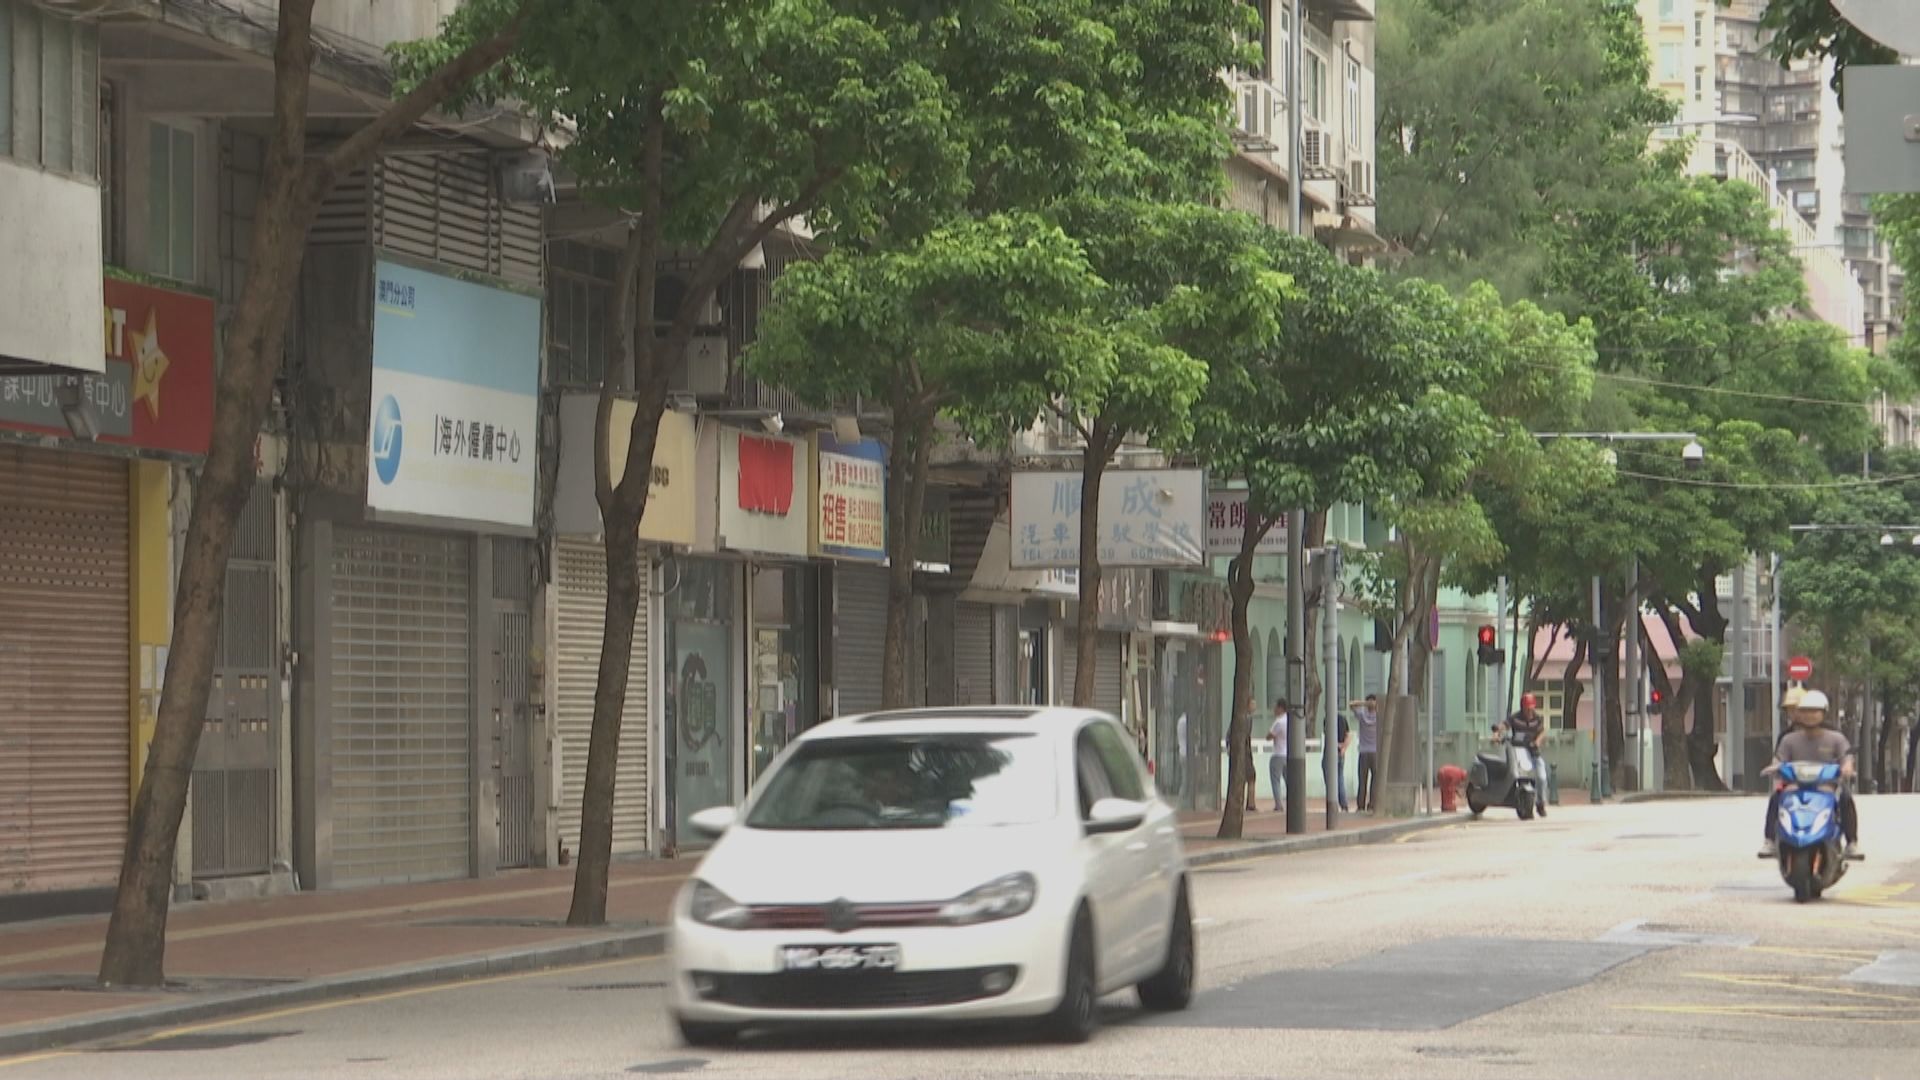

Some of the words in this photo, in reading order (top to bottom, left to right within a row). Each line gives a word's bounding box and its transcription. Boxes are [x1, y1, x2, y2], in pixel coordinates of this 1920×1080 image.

[823, 493, 847, 543] 租售
[1020, 522, 1193, 545] 汽車駛學校
